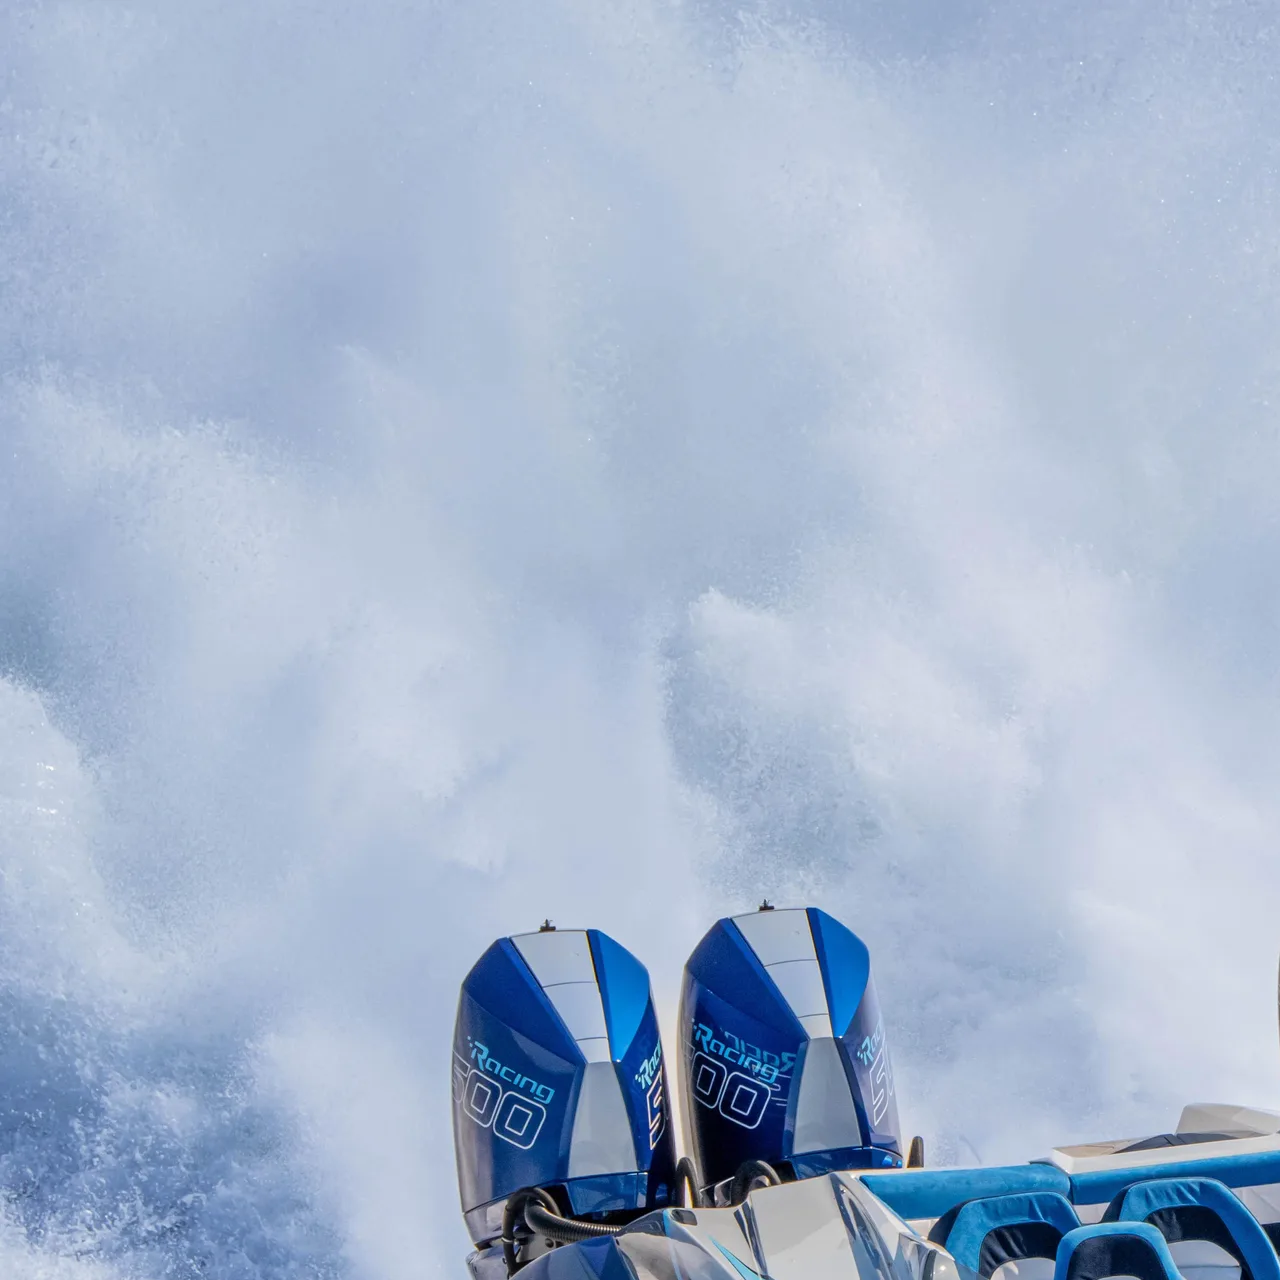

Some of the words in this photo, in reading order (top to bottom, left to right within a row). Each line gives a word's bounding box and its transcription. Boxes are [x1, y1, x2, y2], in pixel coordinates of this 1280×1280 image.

[469, 1041, 555, 1104] Racing
[684, 1040, 772, 1129] 00
[694, 1023, 780, 1084] Racing
